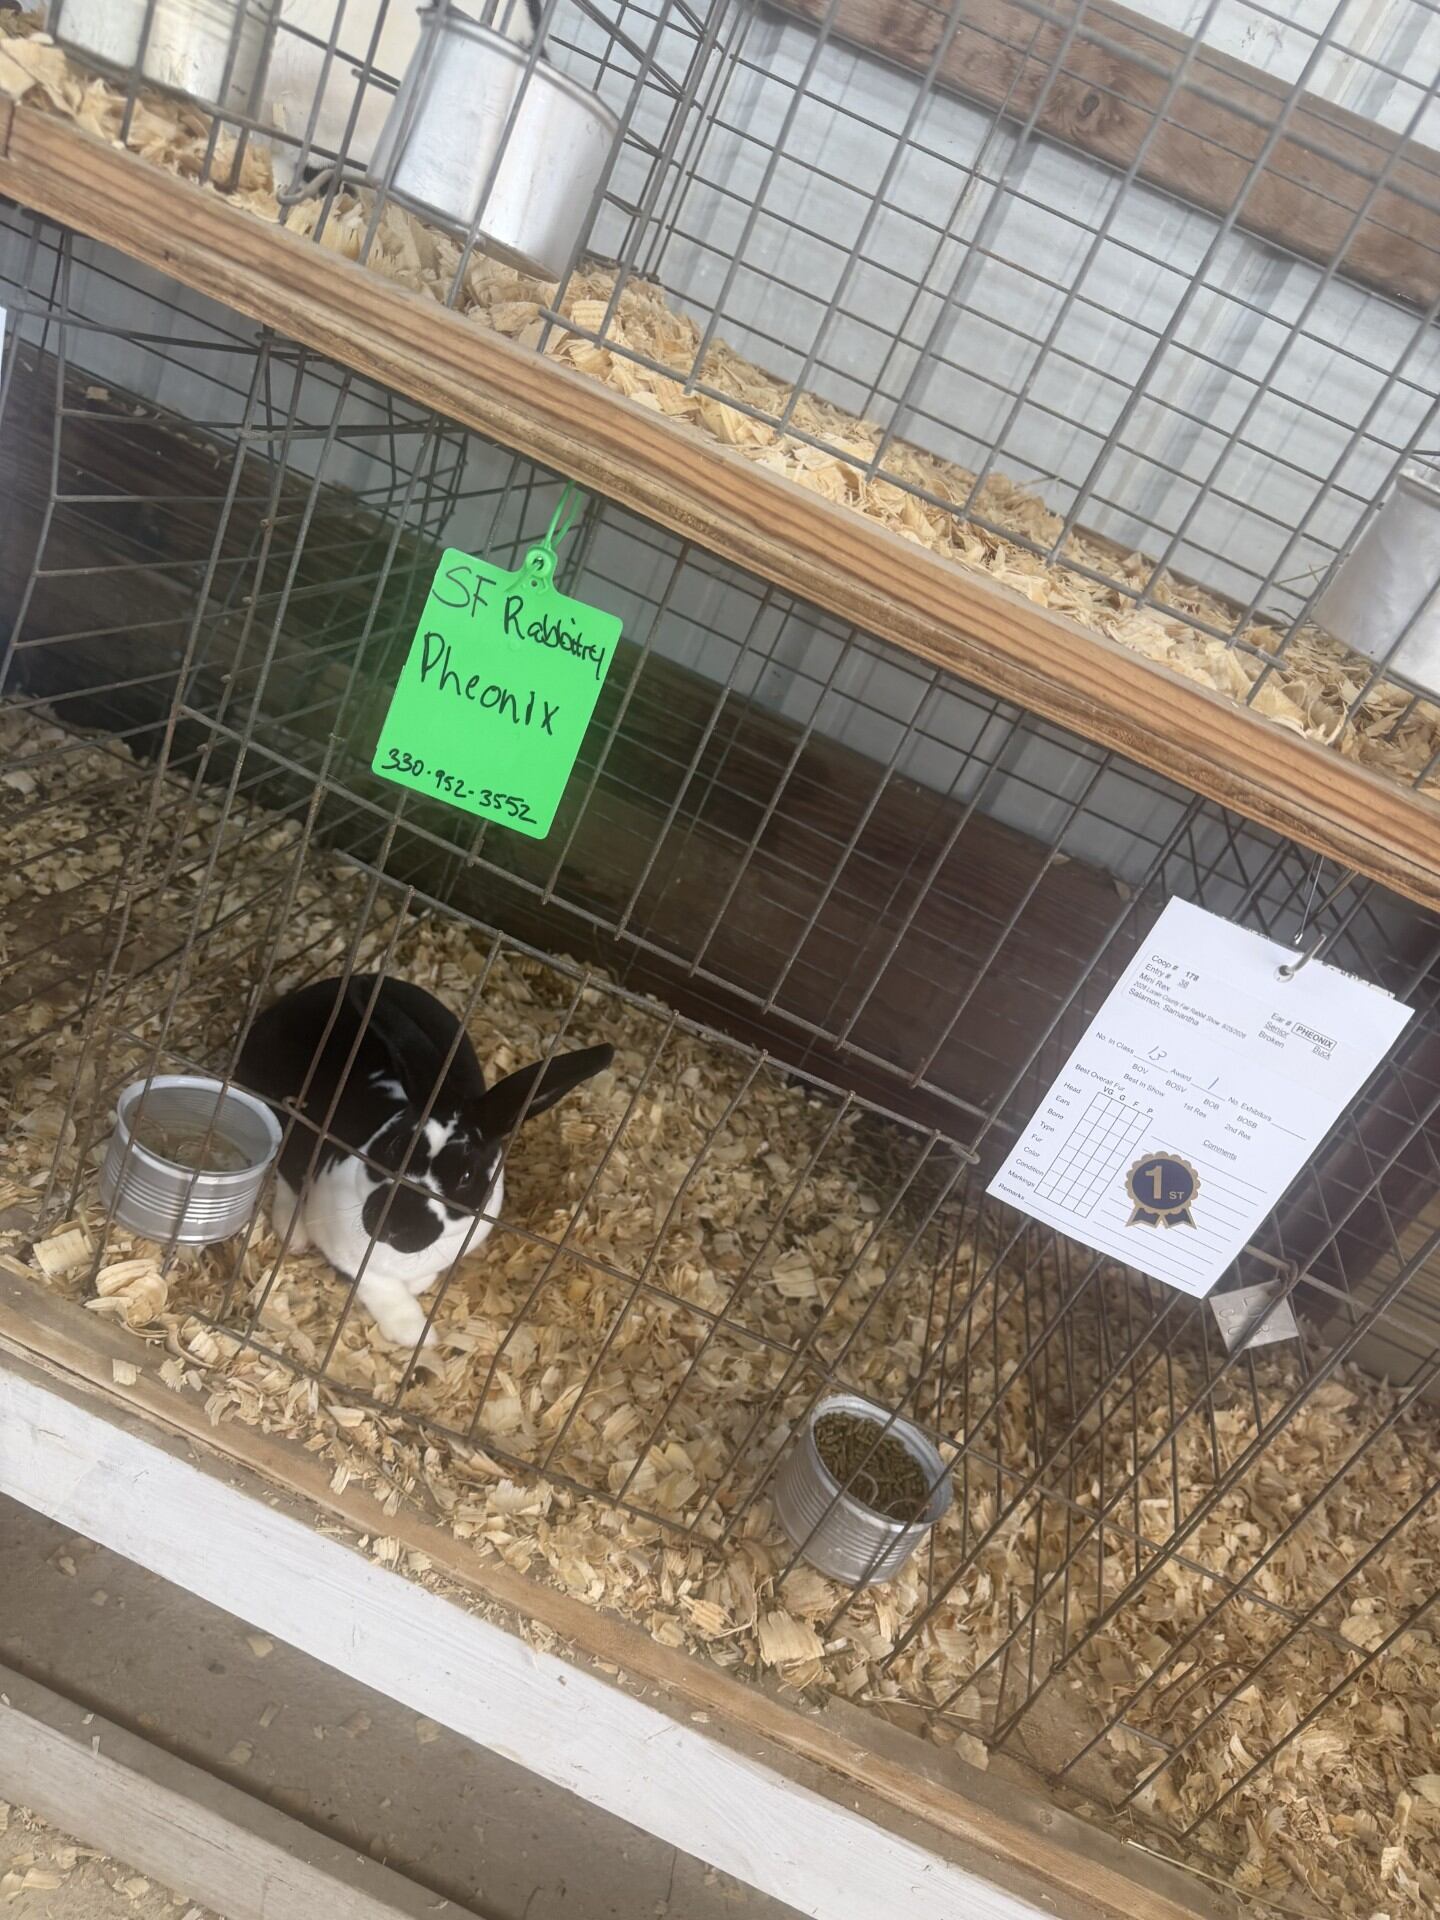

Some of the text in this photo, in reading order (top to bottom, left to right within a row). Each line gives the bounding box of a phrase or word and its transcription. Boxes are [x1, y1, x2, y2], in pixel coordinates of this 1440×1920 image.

[432, 566, 497, 618] SF
[1145, 963, 1165, 978] Entry
[1165, 972, 1172, 980] #
[1151, 954, 1172, 969] Coop
[1185, 970, 1200, 982] 178
[1139, 972, 1171, 992] Mini Rex
[1162, 1003, 1200, 1027] Samantha
[1258, 1030, 1285, 1049] Broken
[1264, 1020, 1332, 1061] Senior Buck
[1271, 1012, 1285, 1024] Ear
[1296, 1025, 1334, 1050] PHEONIX
[1116, 1041, 1135, 1055] Class
[1075, 1063, 1126, 1092] Best Overall Fur
[1131, 1063, 1149, 1075] BOV
[1170, 1068, 1193, 1082] Award
[1063, 1081, 1082, 1094] Head
[1103, 1086, 1115, 1096] VG
[1123, 1073, 1140, 1085] Best
[1146, 1084, 1165, 1097] Show
[1165, 1079, 1188, 1094] BOSV
[1055, 1095, 1071, 1107] Ears
[1183, 1102, 1208, 1119] 1st Res
[1047, 1107, 1065, 1120] Bone
[1240, 1102, 1273, 1122] Exhibitors
[1040, 1120, 1055, 1133] Type
[1224, 1123, 1252, 1141] 2nd Res
[1031, 1133, 1044, 1143] Fur
[1023, 1146, 1041, 1158] Color
[1203, 1139, 1238, 1161] Comments
[1015, 1158, 1045, 1177] Condition
[1007, 1169, 1036, 1189] Markings
[1144, 1165, 1185, 1200] 1 ST
[998, 1182, 1026, 1201] Remarks
